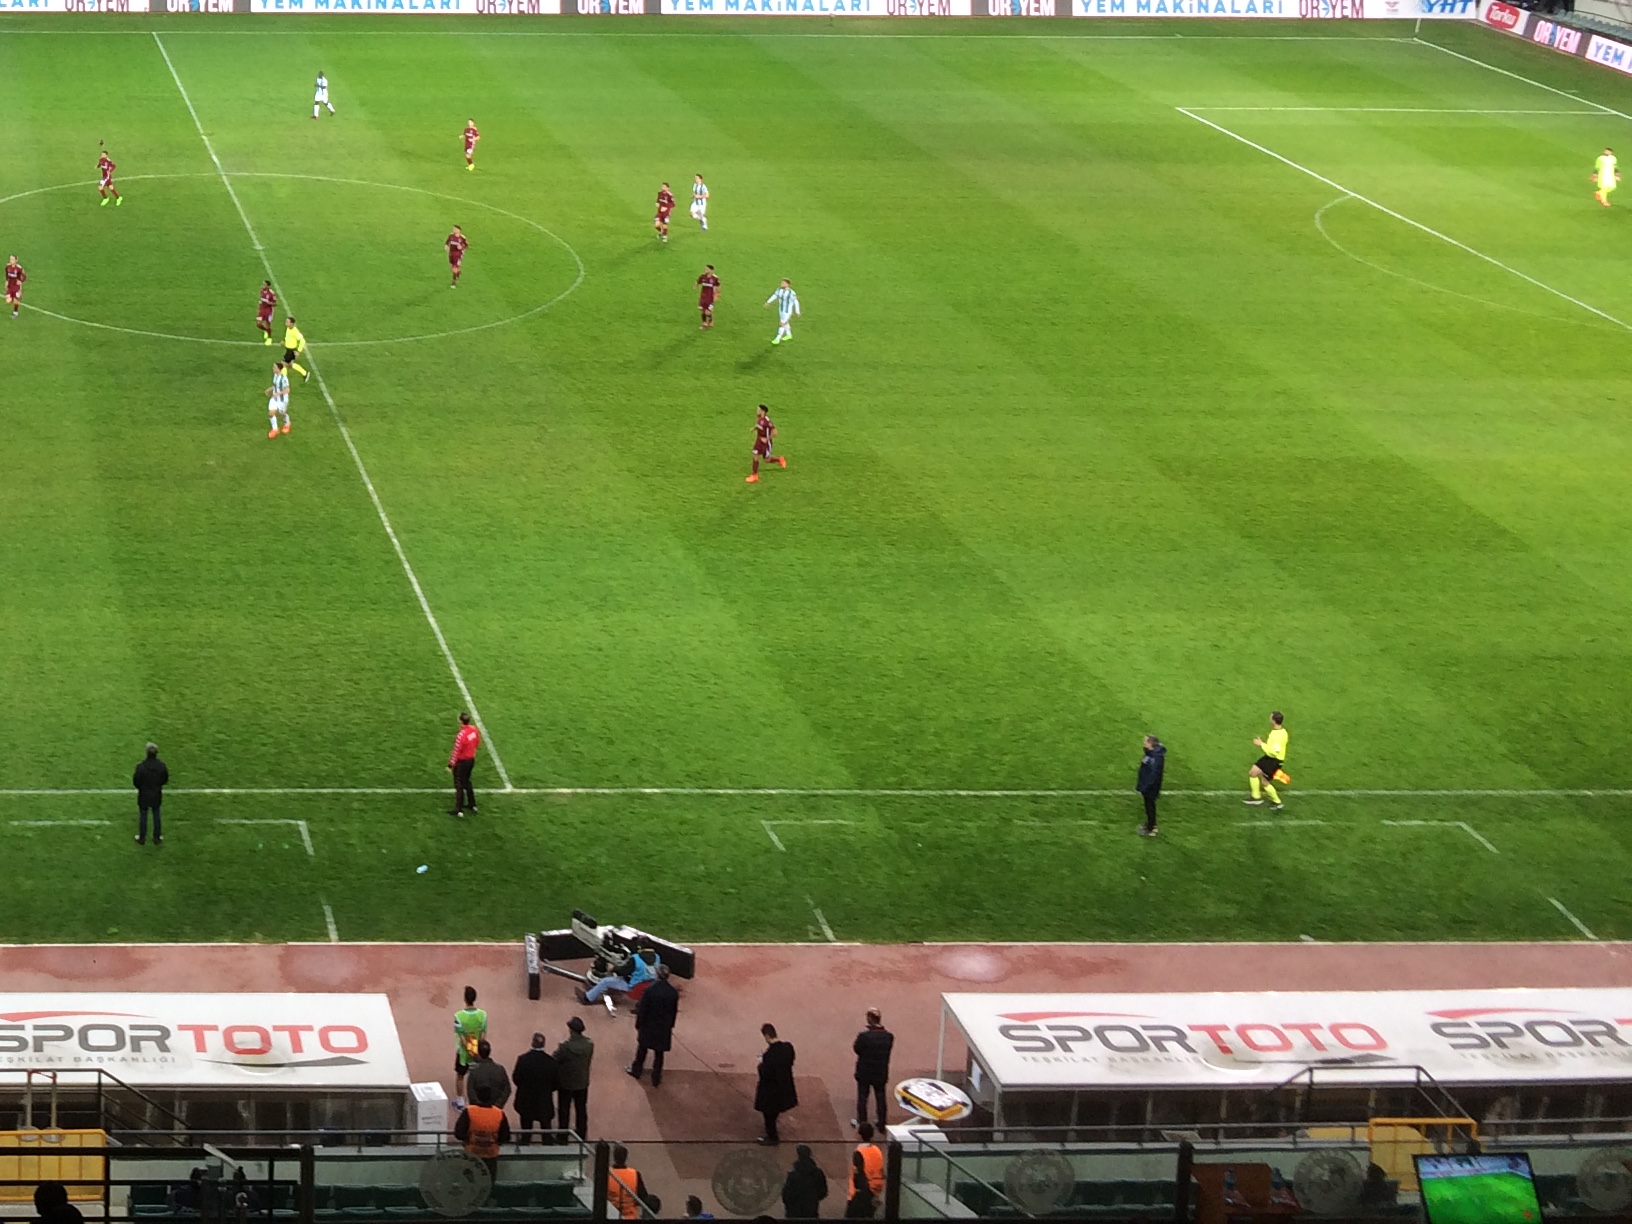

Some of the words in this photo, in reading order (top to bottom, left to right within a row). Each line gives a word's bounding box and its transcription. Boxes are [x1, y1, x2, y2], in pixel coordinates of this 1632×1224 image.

[1488, 5, 1517, 25] Torku
[1595, 41, 1627, 66] YEM
[1429, 1019, 1632, 1050] SPOR
